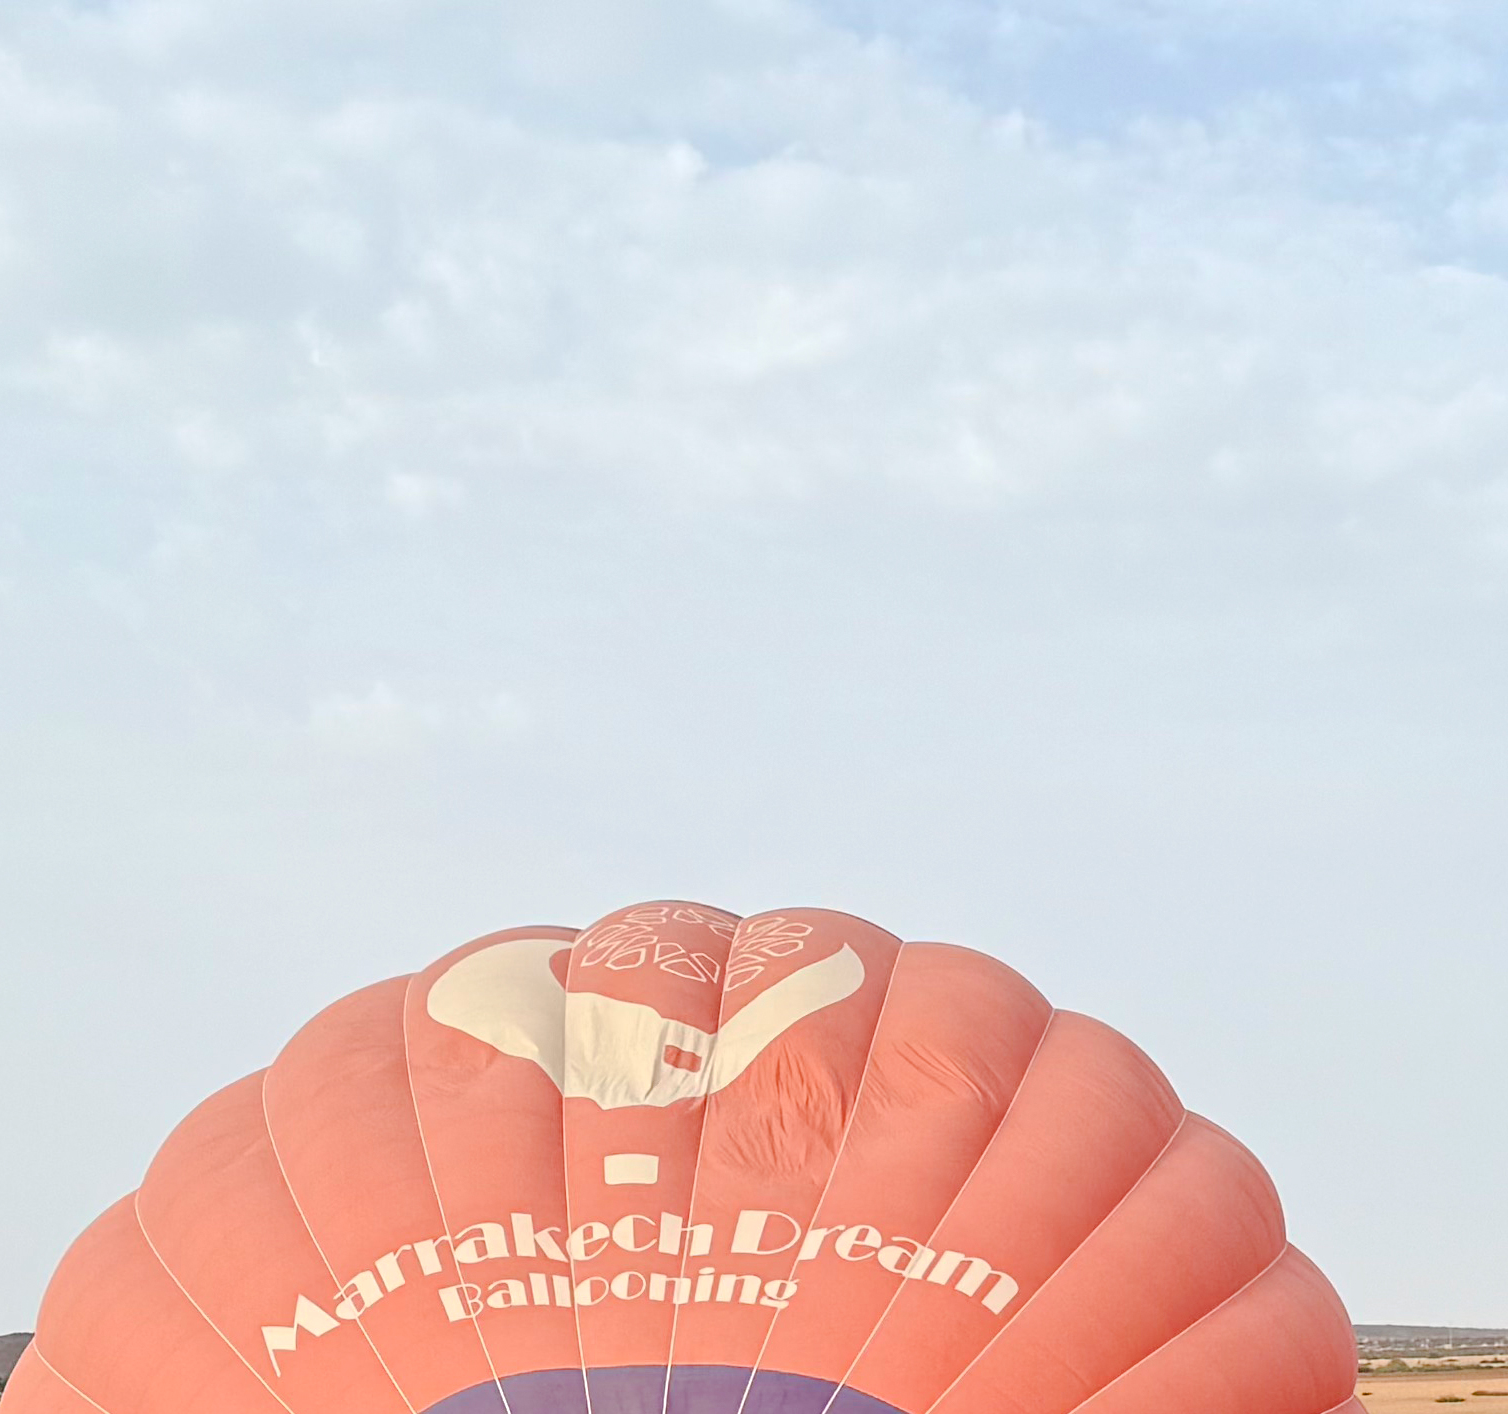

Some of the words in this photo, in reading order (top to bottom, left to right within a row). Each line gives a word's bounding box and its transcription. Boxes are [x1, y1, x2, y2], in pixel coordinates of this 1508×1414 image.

[260, 1210, 714, 1378] Marrakech
[730, 1209, 1020, 1316] Dream
[438, 1266, 799, 1323] Ballooning
